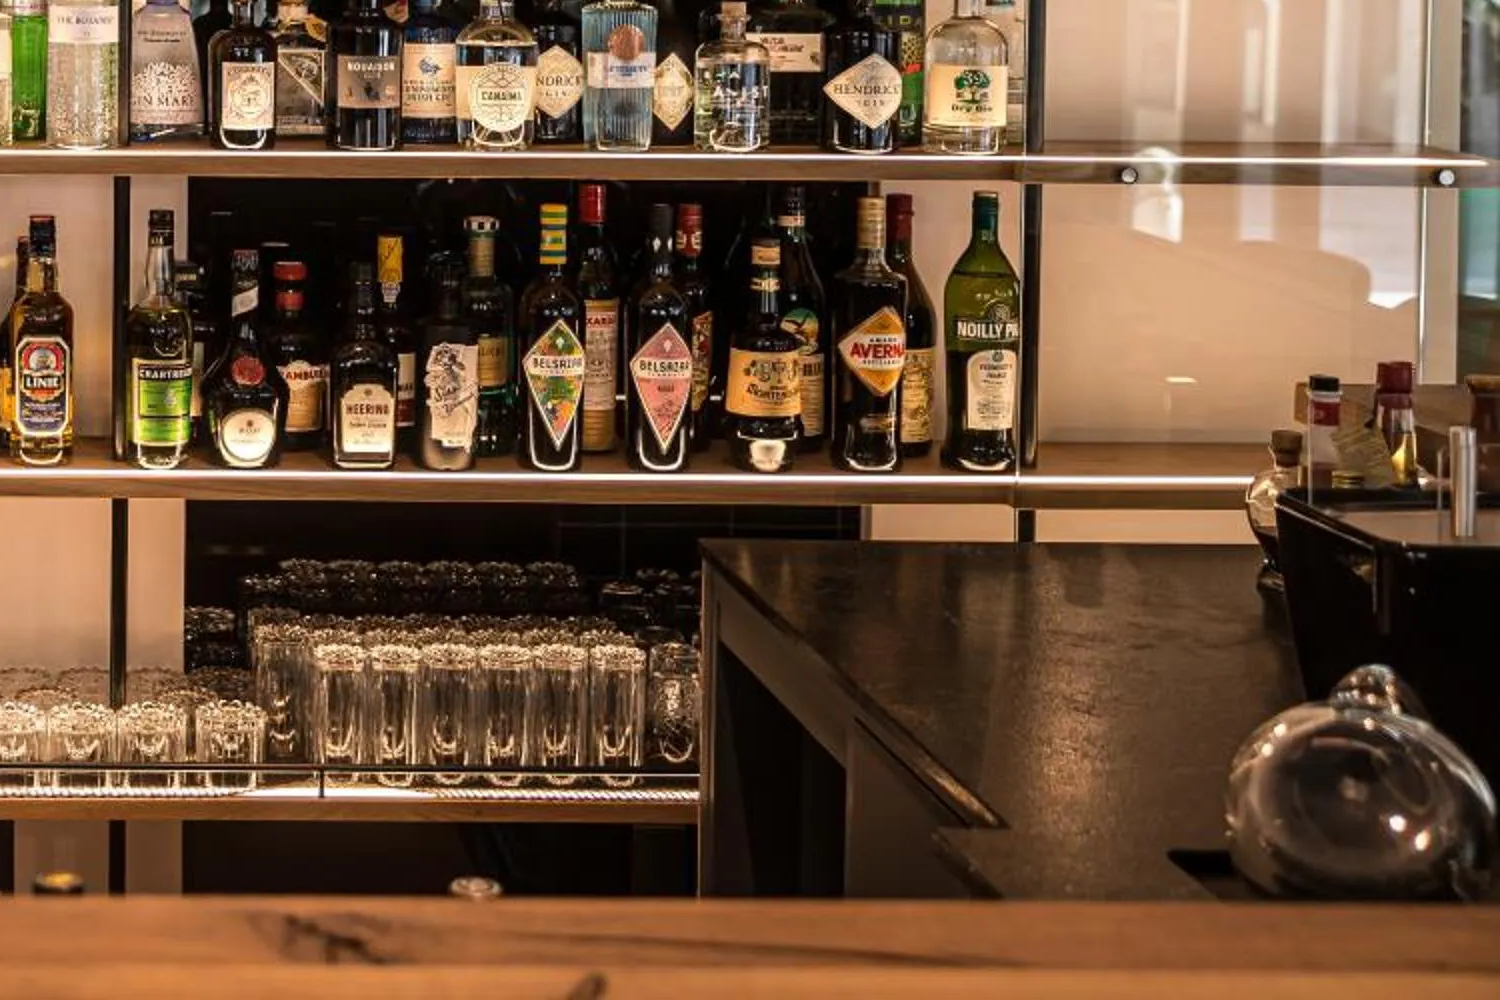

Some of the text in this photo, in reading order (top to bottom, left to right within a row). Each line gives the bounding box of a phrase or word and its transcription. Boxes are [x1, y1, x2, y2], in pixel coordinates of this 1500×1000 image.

[957, 320, 1004, 338] NOILLY
[25, 374, 61, 388] LINIE
[346, 402, 390, 415] HEERING
